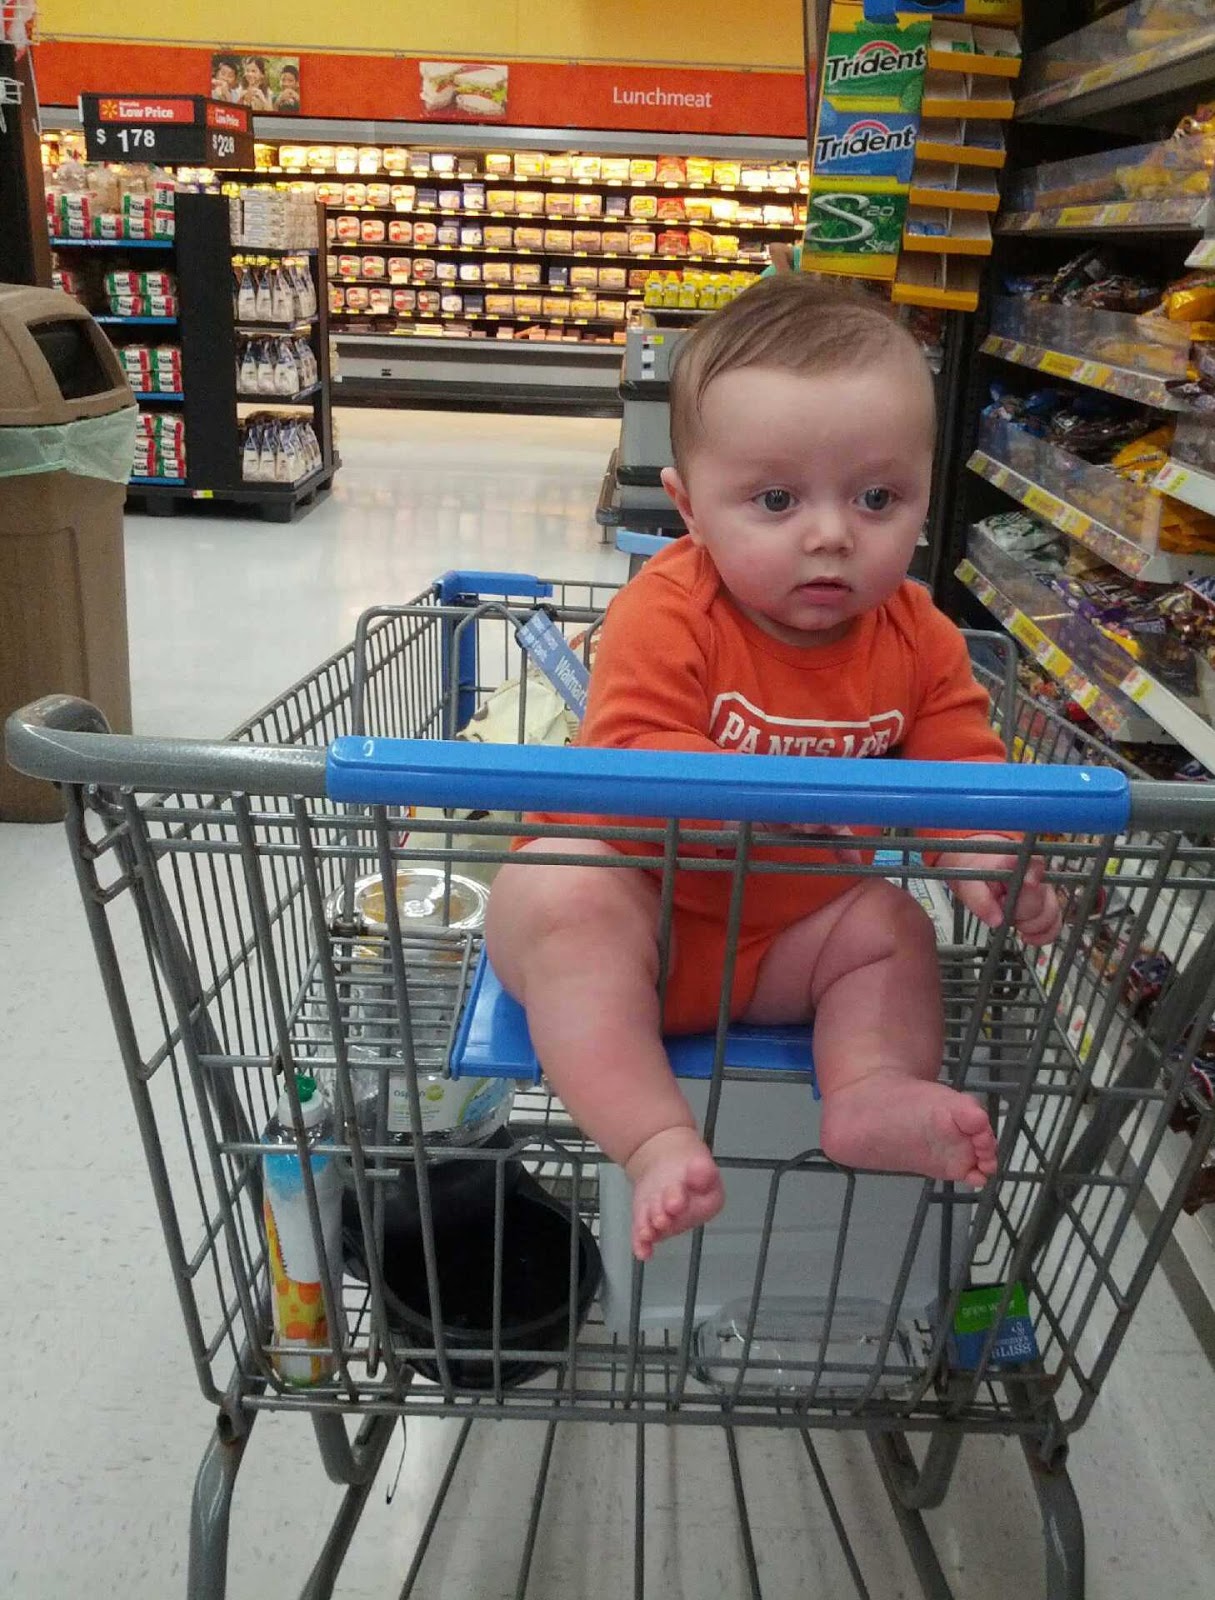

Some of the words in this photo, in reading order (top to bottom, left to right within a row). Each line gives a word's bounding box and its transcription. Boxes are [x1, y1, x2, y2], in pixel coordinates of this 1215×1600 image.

[828, 47, 926, 83] Trident
[119, 106, 144, 118] Low
[145, 107, 174, 119] Price
[613, 86, 712, 108] Lunchmeat
[817, 125, 916, 162] Trident
[715, 711, 835, 756] PANTS
